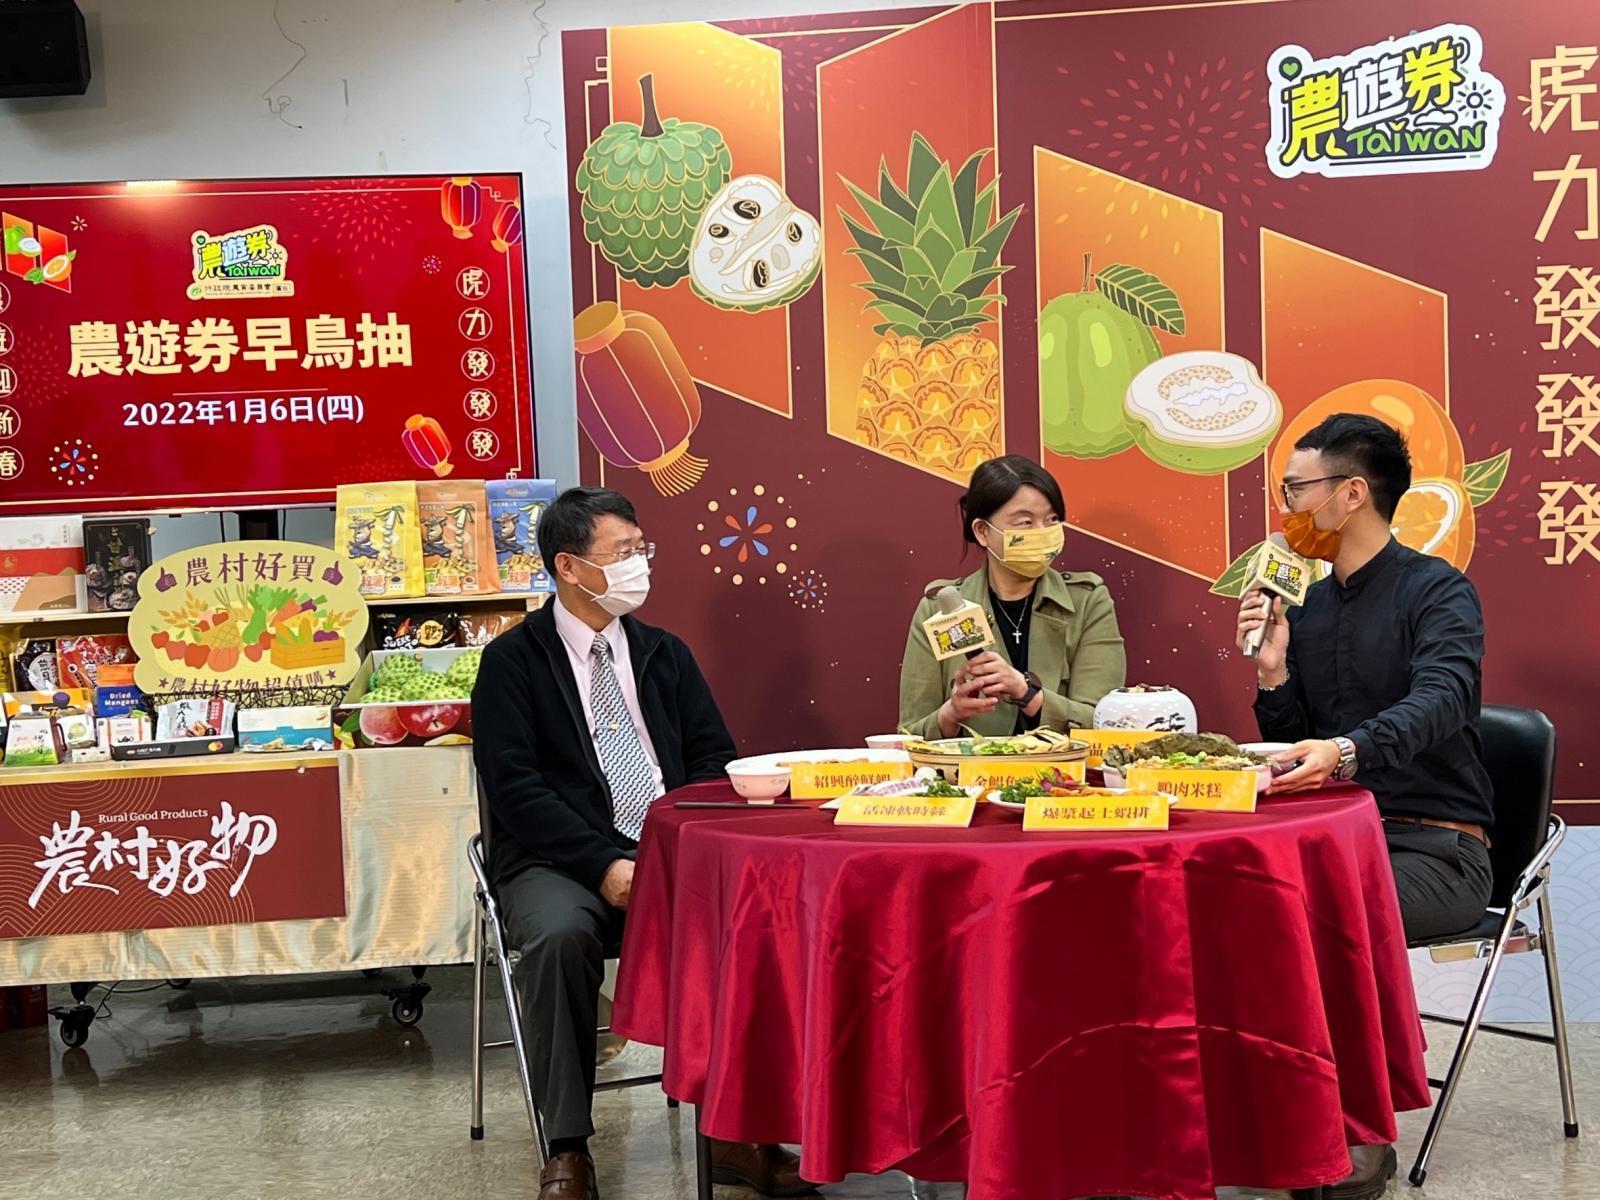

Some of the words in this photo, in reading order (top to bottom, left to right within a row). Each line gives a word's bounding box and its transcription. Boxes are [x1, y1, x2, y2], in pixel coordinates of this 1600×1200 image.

[1282, 36, 1463, 164] 農遊券
[198, 230, 271, 279] 農遊券
[1530, 45, 1600, 566] 虎力發發發
[67, 312, 413, 379] 農遊券早鳥抽
[461, 269, 495, 457] 虎力發發發
[122, 395, 365, 427] 2022年1月6日(四)
[185, 552, 316, 588] 農村好買
[98, 812, 129, 824] Rural
[129, 811, 158, 822] Good
[160, 808, 208, 820] Products
[1157, 781, 1223, 799] 鴨肉米糕
[28, 801, 278, 909] 農村好物
